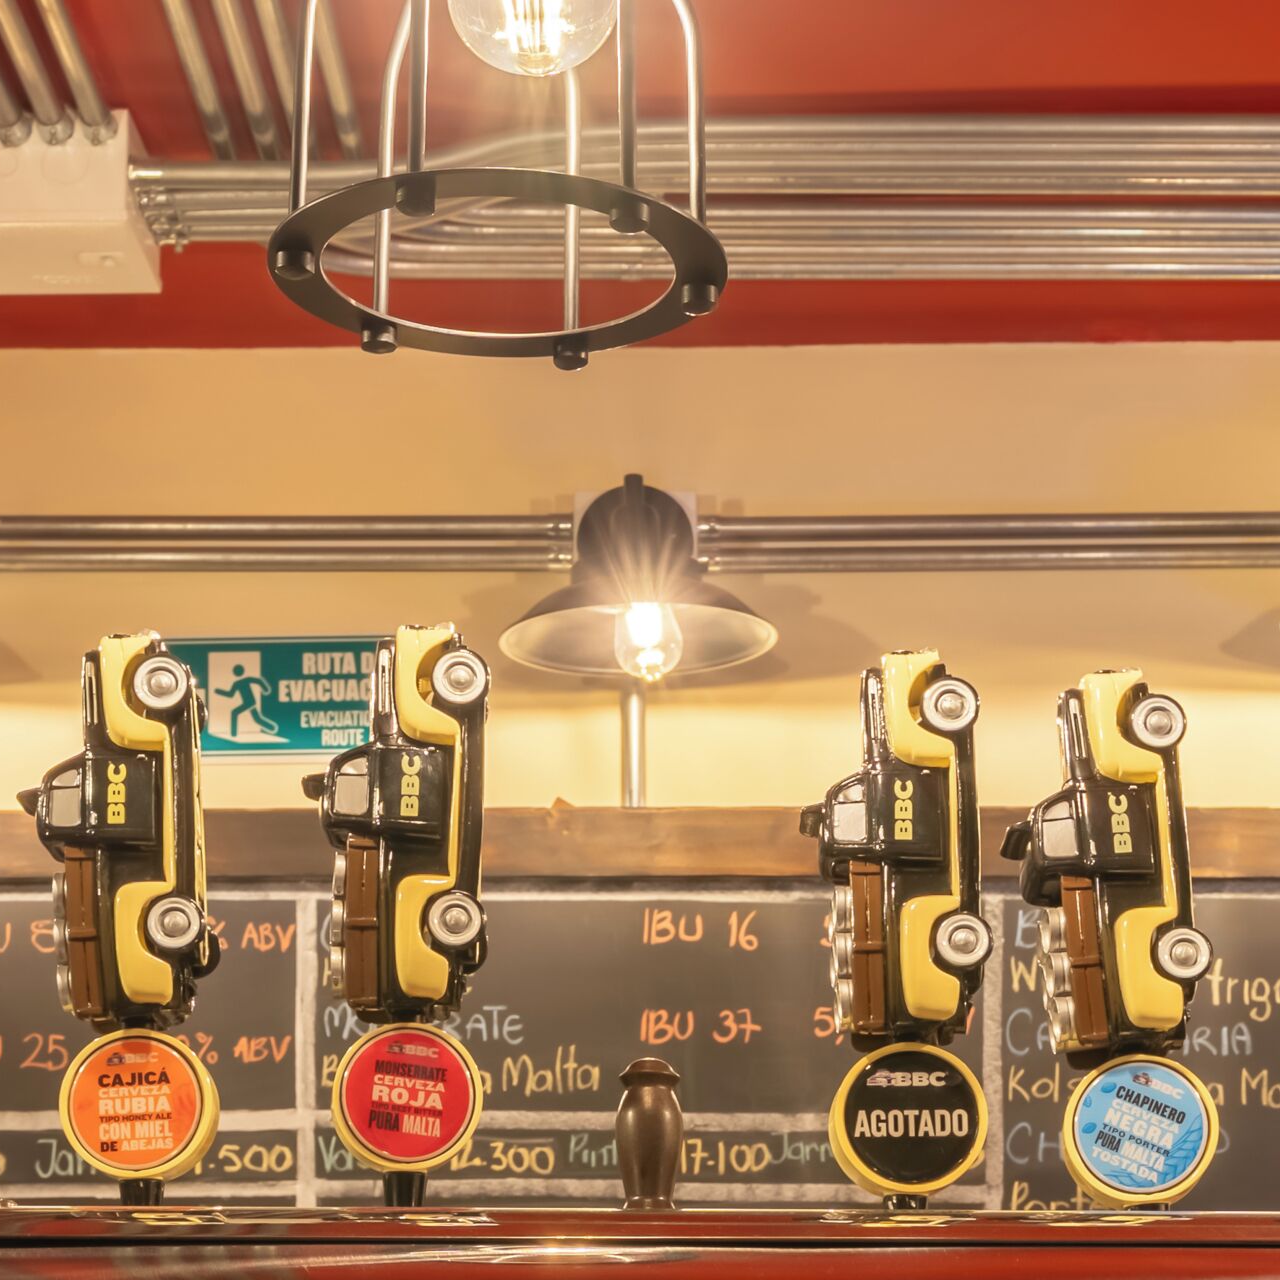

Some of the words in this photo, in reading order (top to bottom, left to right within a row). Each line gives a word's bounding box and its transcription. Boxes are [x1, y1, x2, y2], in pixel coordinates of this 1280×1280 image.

[302, 652, 357, 675] RUTA
[361, 652, 376, 674] D
[278, 679, 371, 702] EVACUAC
[300, 711, 370, 728] EVACUATIO
[322, 728, 365, 747] ROUTE
[106, 761, 127, 825] BBC
[399, 754, 421, 817] BBC
[894, 778, 913, 841] BBC
[1112, 793, 1133, 854] BBC
[240, 921, 298, 953] ABV
[642, 908, 703, 945] IBU
[728, 910, 760, 951] 16
[640, 1009, 696, 1046] IBU
[711, 1008, 762, 1045] 37
[19, 1032, 69, 1072] 25
[232, 1035, 293, 1065] ABV
[404, 1044, 440, 1059] BBC
[98, 1067, 170, 1087] CAJICÁ
[374, 1074, 446, 1093] CERVEZA
[375, 1060, 448, 1083] MONSERRATE
[502, 1045, 600, 1098] Malta
[893, 1071, 947, 1087] BBC
[98, 1085, 170, 1098] CERVEZA
[99, 1096, 171, 1116] RUBIA
[371, 1084, 443, 1110] ROJA
[1115, 1085, 1187, 1125] CHAPINERO
[99, 1115, 120, 1123] TIPO
[122, 1114, 154, 1122] HONEY
[155, 1112, 172, 1121] ALE
[99, 1122, 131, 1141] CON
[135, 1120, 173, 1139] MIEL
[368, 1109, 400, 1132] PURA
[402, 1114, 441, 1138] MALTA
[854, 1108, 969, 1138] AGOTADO
[1103, 1107, 1175, 1148] NEGRA
[1111, 1098, 1180, 1134] CERVEZA
[100, 1141, 118, 1152] DE
[121, 1138, 174, 1152] ABEJAS
[1094, 1130, 1121, 1153] PURA
[1120, 1141, 1166, 1173] MALTA
[1102, 1123, 1126, 1138] TIPO
[1128, 1135, 1171, 1157] PORTER
[1091, 1146, 1158, 1184] TOSTADA
